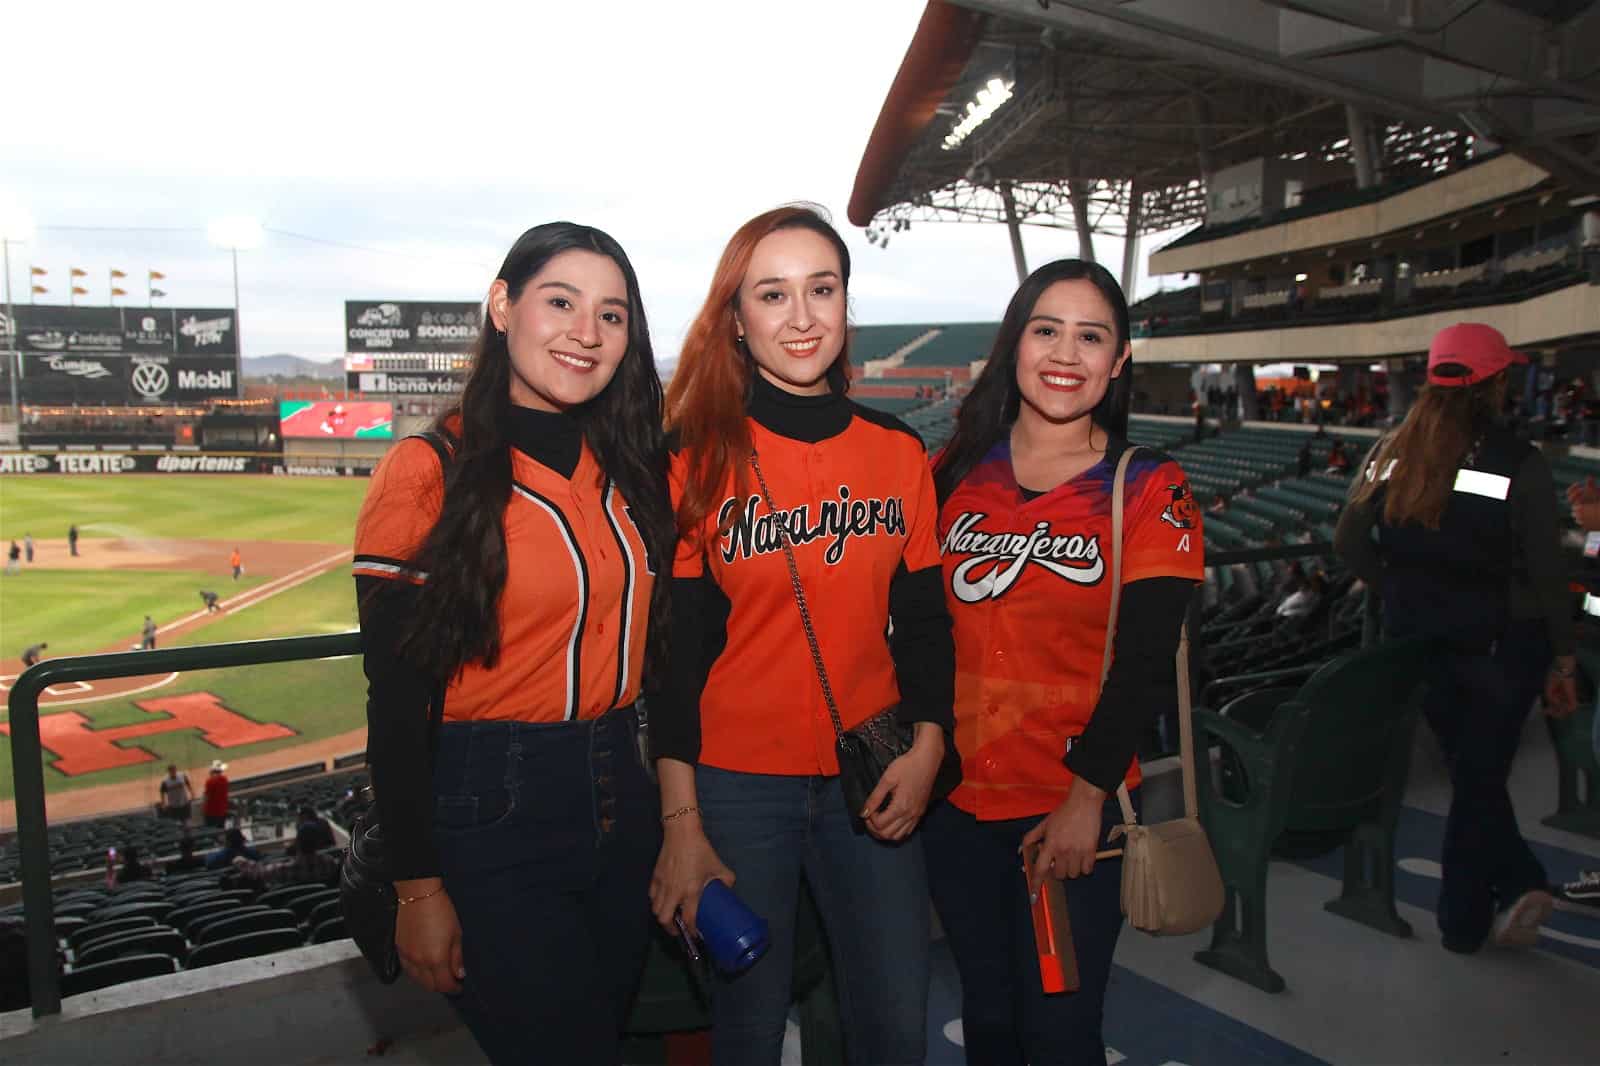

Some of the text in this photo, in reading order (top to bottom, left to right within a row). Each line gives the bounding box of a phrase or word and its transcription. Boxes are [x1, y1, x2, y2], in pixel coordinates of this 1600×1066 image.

[349, 329, 411, 339] CONCRETOS
[417, 325, 479, 338] SONORA
[178, 370, 232, 389] Mobil
[55, 454, 122, 473] TECATE
[156, 455, 245, 472] dportenis
[939, 511, 1104, 602] Naranjeros
